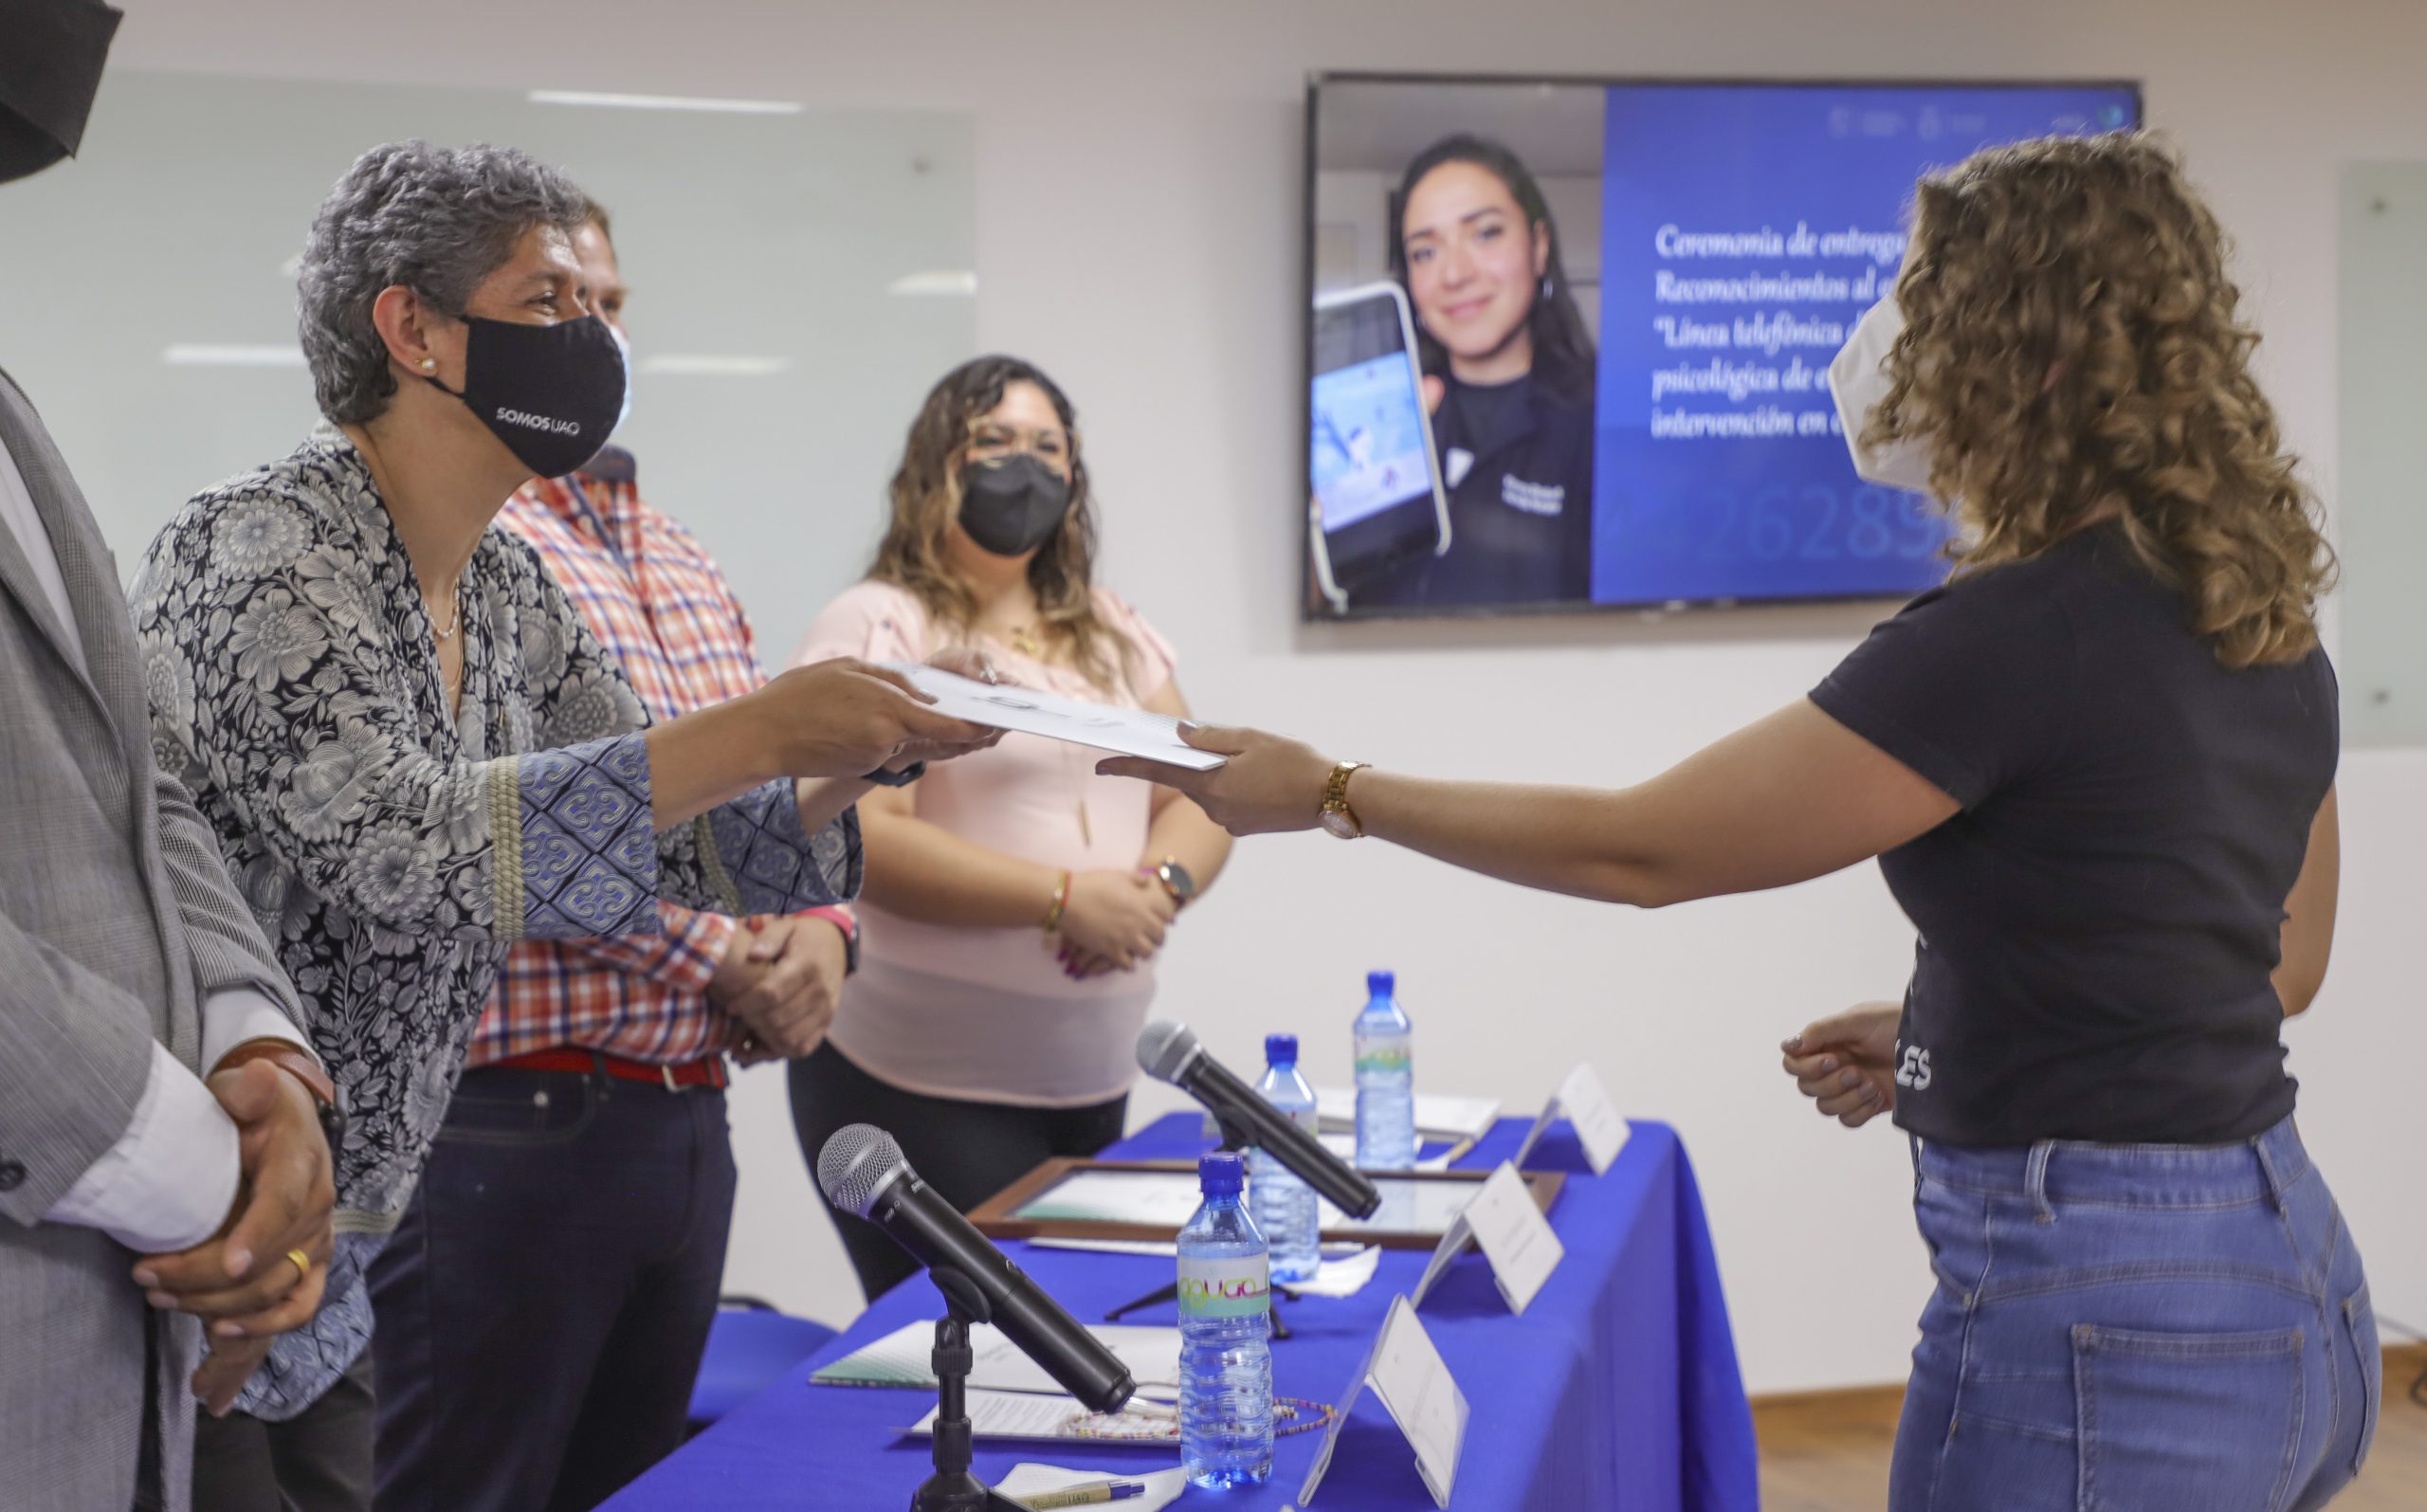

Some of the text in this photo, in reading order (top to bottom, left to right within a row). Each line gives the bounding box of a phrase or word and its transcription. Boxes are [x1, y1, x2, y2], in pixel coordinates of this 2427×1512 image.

[1655, 224, 1783, 258] Ceremonia
[1786, 220, 1817, 257] de
[1655, 269, 1849, 302] Reconocimientos
[1851, 264, 1875, 302] al
[1733, 310, 1843, 356] telefónica
[1651, 356, 1779, 402] psicológica
[1781, 355, 1813, 392] de
[1651, 405, 1794, 439] intervención
[1797, 410, 1828, 437] en
